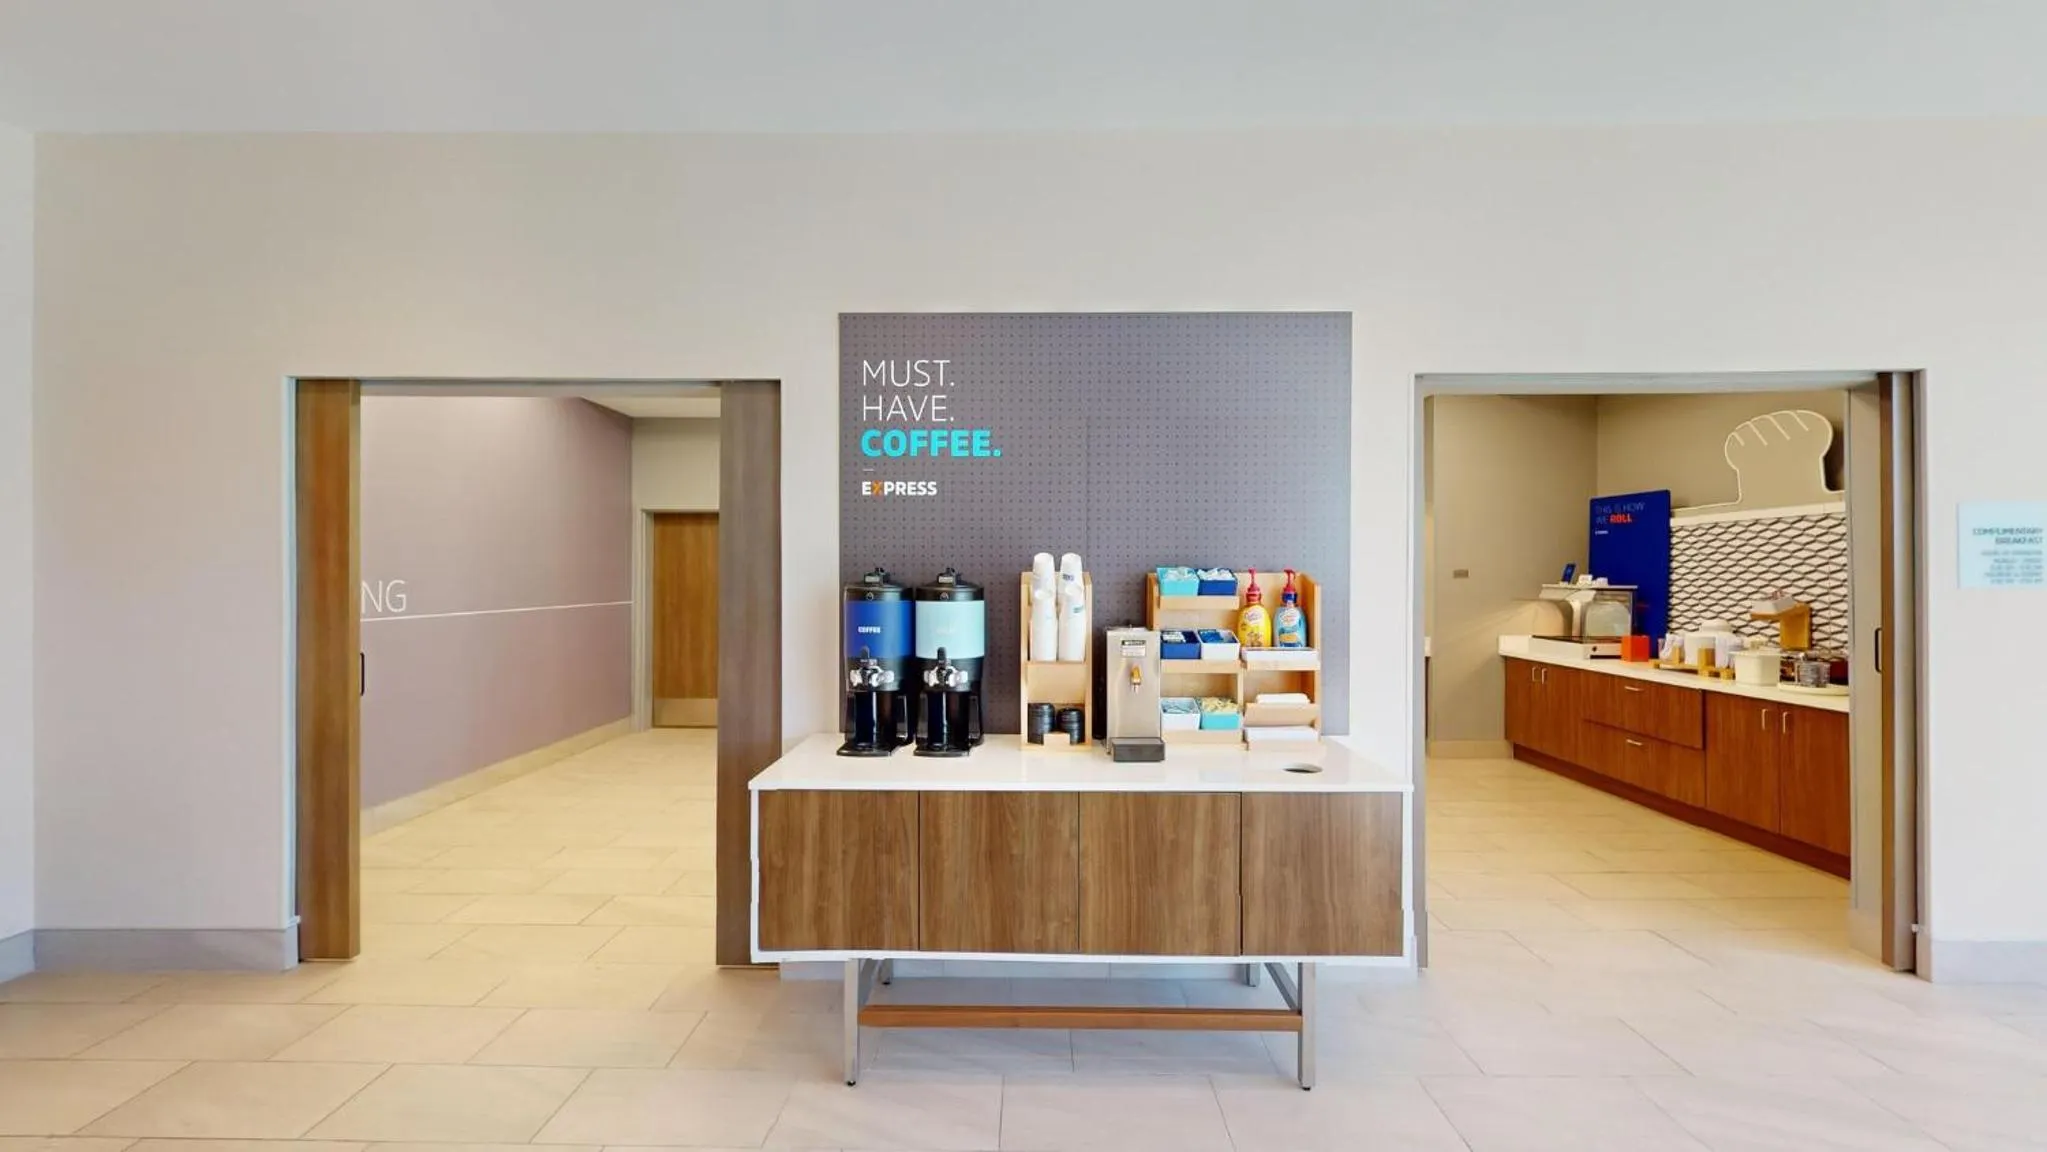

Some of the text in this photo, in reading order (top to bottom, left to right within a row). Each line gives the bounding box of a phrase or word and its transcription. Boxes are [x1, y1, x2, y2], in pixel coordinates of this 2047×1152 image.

[863, 359, 955, 387] MUST.
[863, 394, 954, 422] HAVE.
[861, 429, 1002, 457] COFFEE.
[861, 481, 938, 496] EXPRESS
